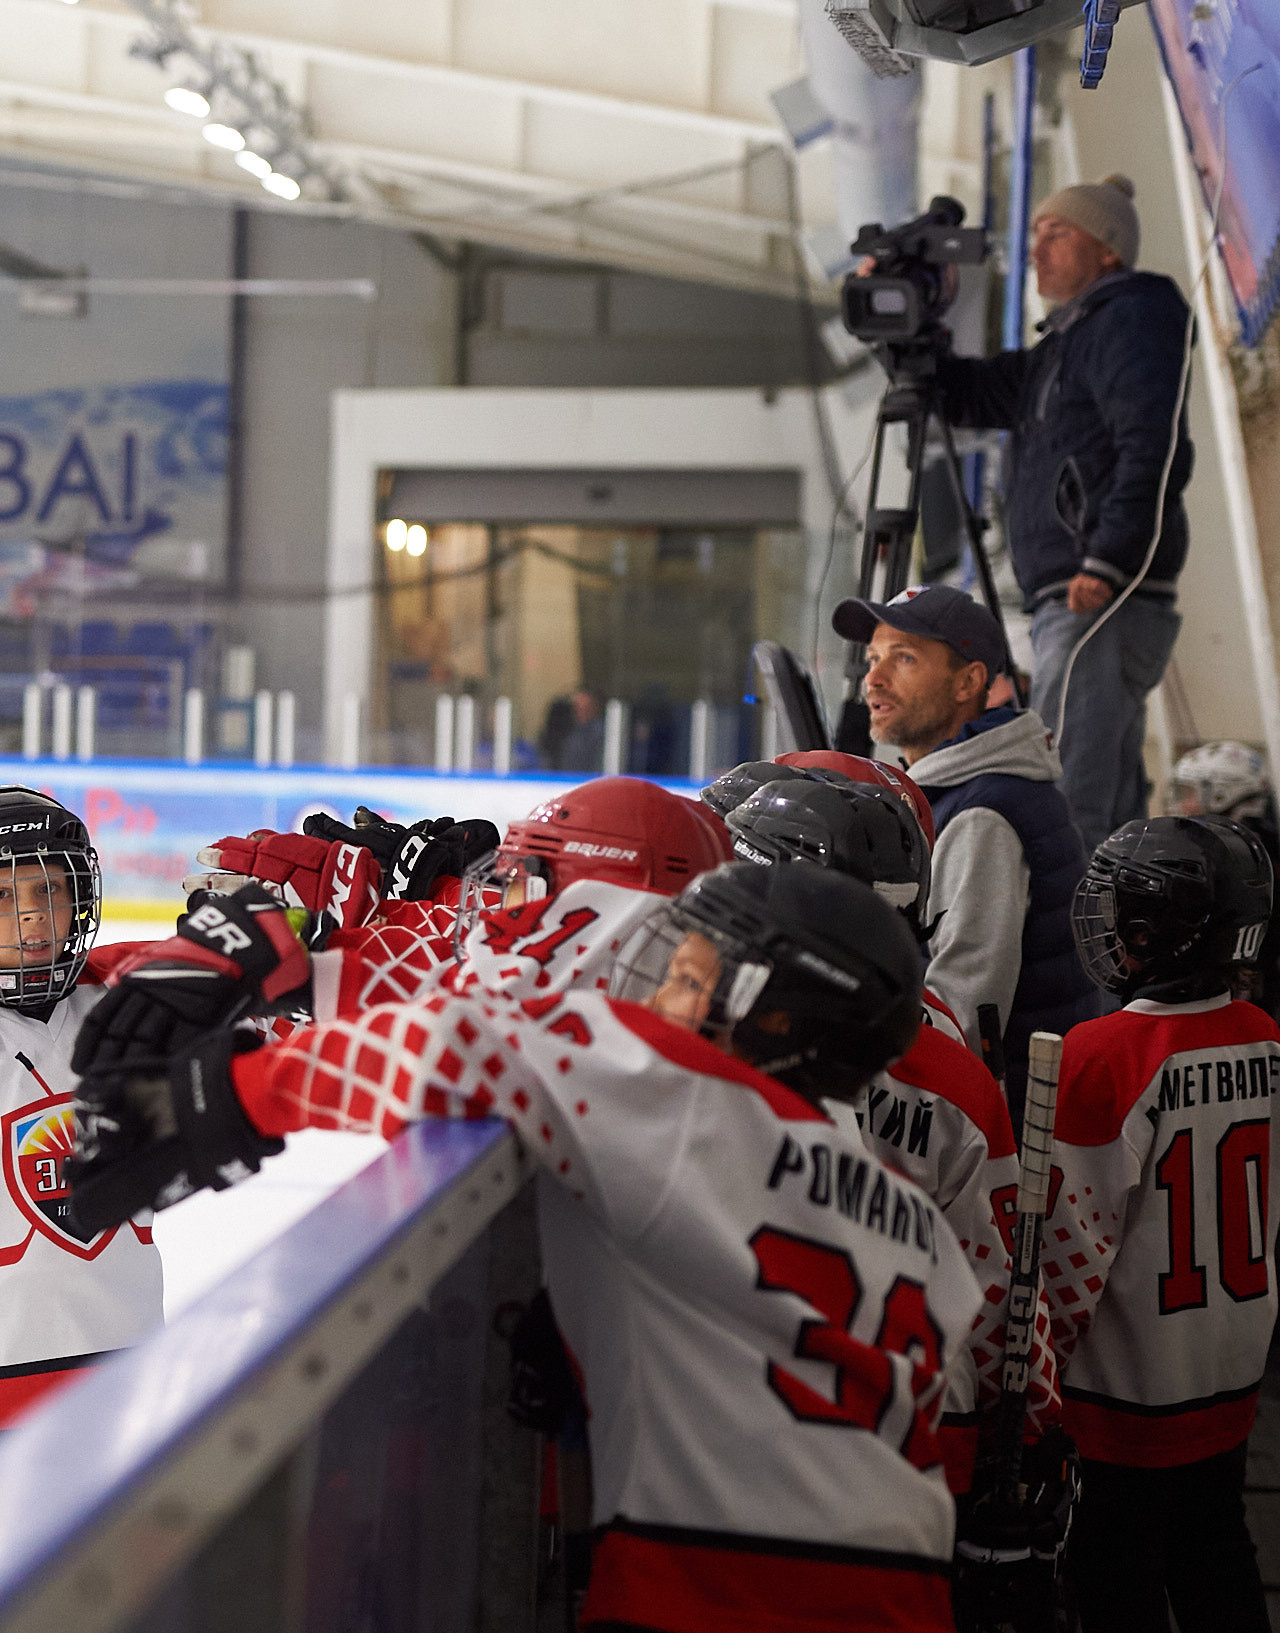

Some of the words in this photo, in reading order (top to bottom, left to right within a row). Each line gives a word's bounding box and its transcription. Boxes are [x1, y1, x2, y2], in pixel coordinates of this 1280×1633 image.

[563, 841, 638, 862] BAUER
[733, 836, 773, 867] BAUER
[1231, 922, 1264, 960] 10
[1148, 1055, 1280, 1116] МЕТВАЛЕ
[1155, 1117, 1271, 1316] 10
